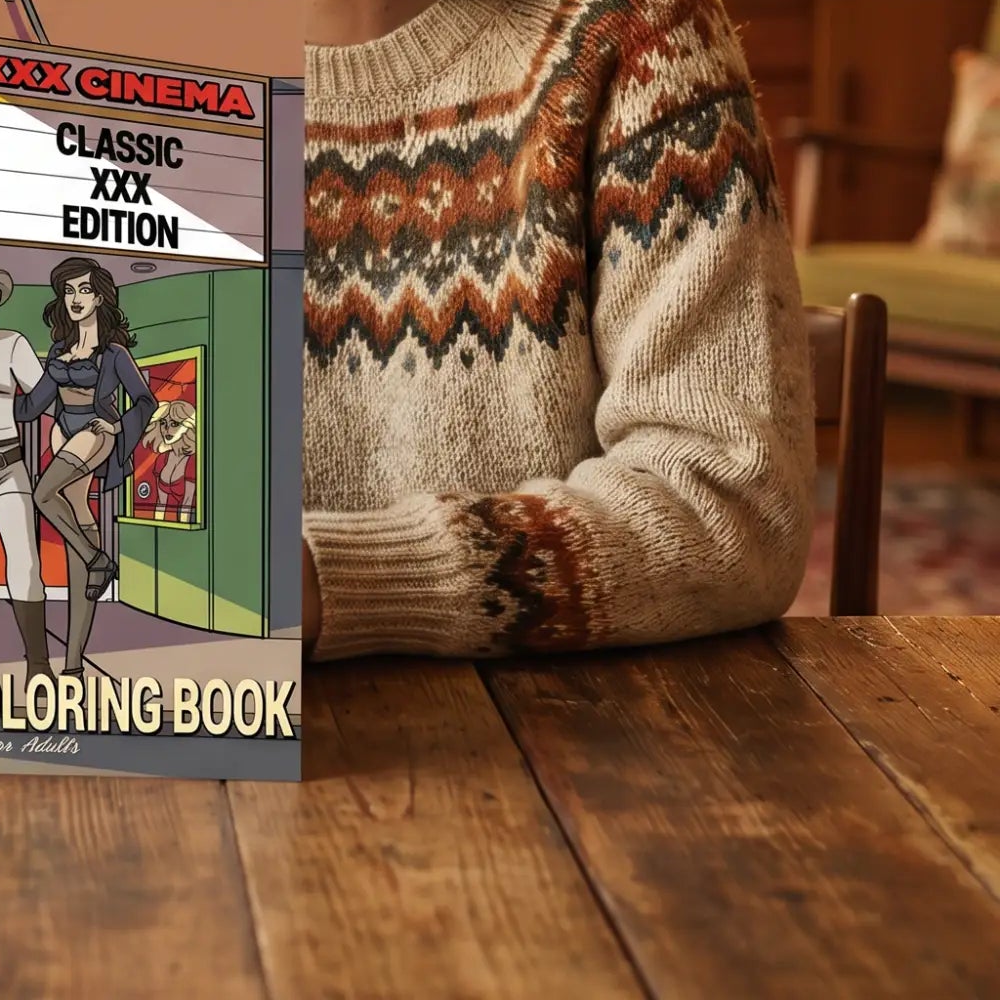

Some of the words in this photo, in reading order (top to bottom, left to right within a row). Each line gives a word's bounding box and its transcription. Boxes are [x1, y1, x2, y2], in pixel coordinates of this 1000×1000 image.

[79, 67, 255, 120] CINEMA
[56, 121, 184, 169] CLASSIC
[90, 167, 151, 205] XXX
[62, 204, 179, 249] EDITION
[173, 677, 296, 740] BOOK
